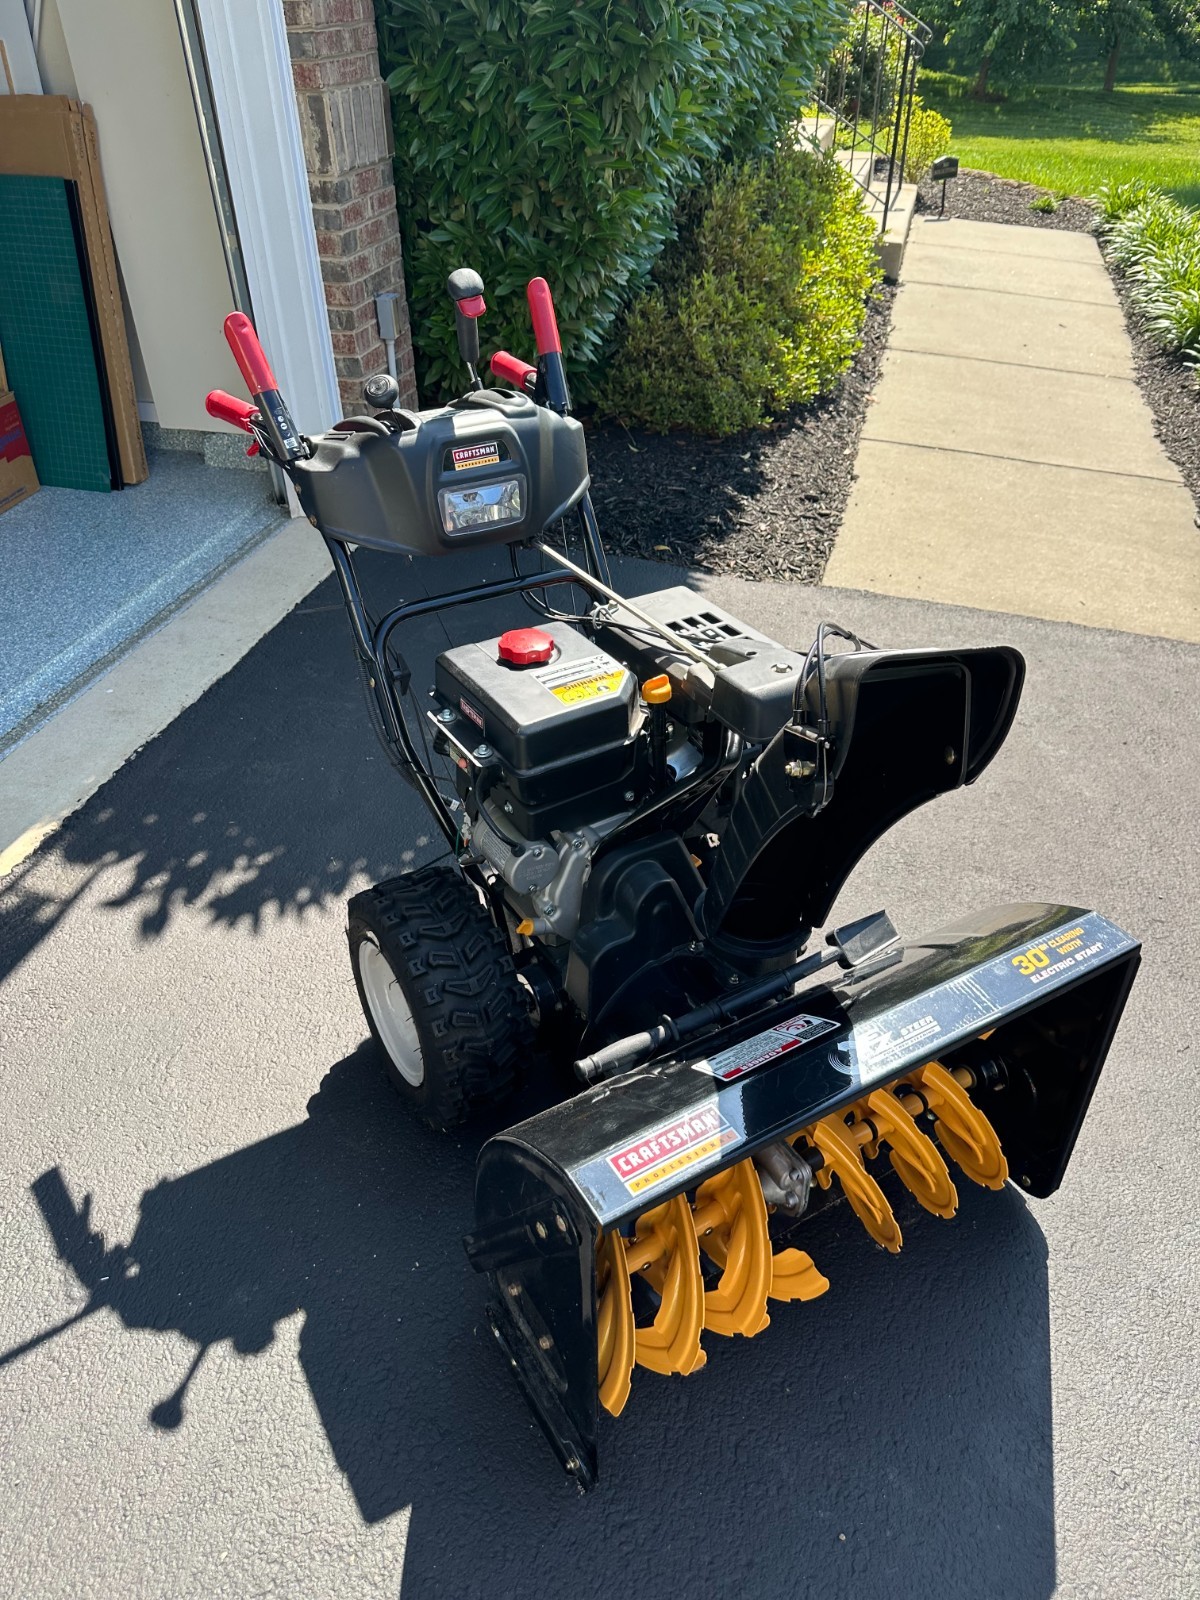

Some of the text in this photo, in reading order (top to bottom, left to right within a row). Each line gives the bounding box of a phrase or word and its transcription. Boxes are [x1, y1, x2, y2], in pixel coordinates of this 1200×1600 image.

[455, 445, 496, 460] CRAFTSMAN
[563, 675, 607, 690] WARNING
[1047, 927, 1084, 948] CLEARING
[1057, 939, 1083, 955] WIDTH
[1030, 943, 1105, 984] ELECTRIC START
[900, 1015, 934, 1036] STEER
[741, 1051, 777, 1070] DANGER
[618, 1112, 720, 1173] CRAFTSMAN
[635, 1134, 733, 1189] PROFESSIONAL
